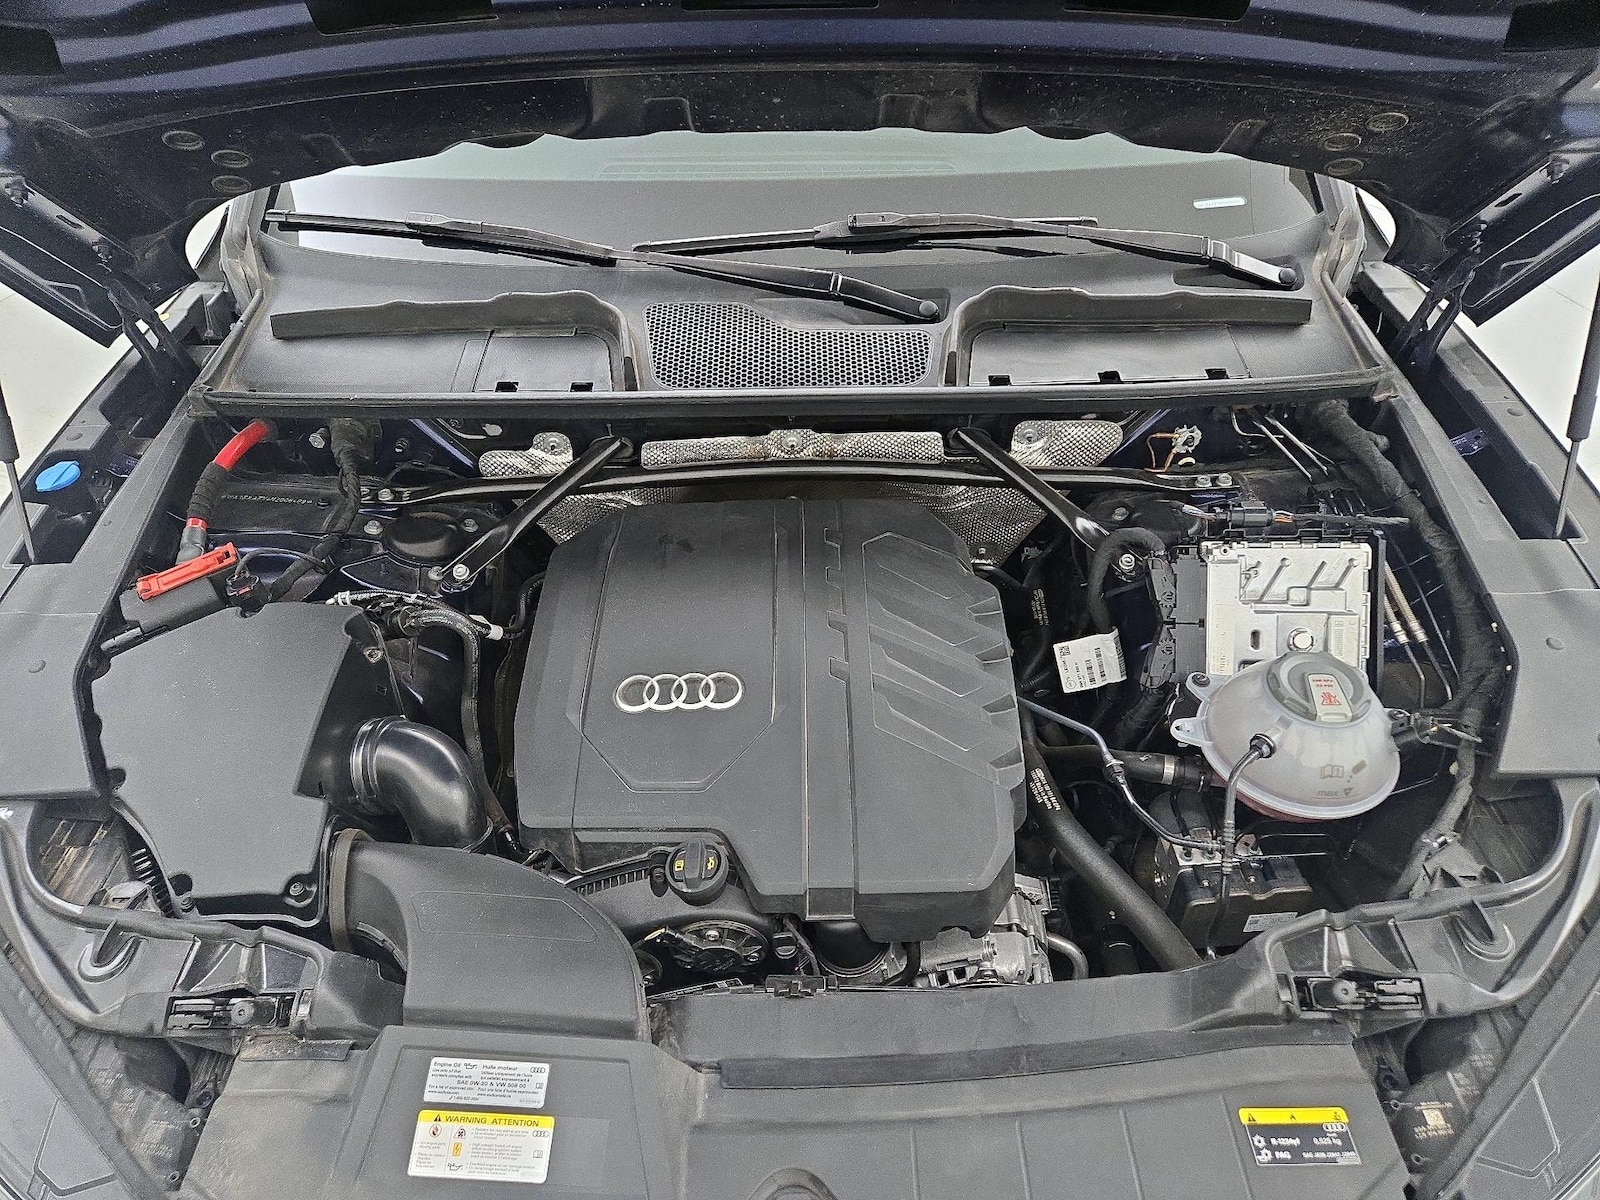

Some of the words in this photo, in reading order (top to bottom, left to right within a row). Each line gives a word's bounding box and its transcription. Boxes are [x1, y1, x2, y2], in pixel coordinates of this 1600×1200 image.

[1317, 789, 1339, 797] max
[446, 1115, 487, 1123] WARNING
[1275, 1151, 1291, 1159] PAG
